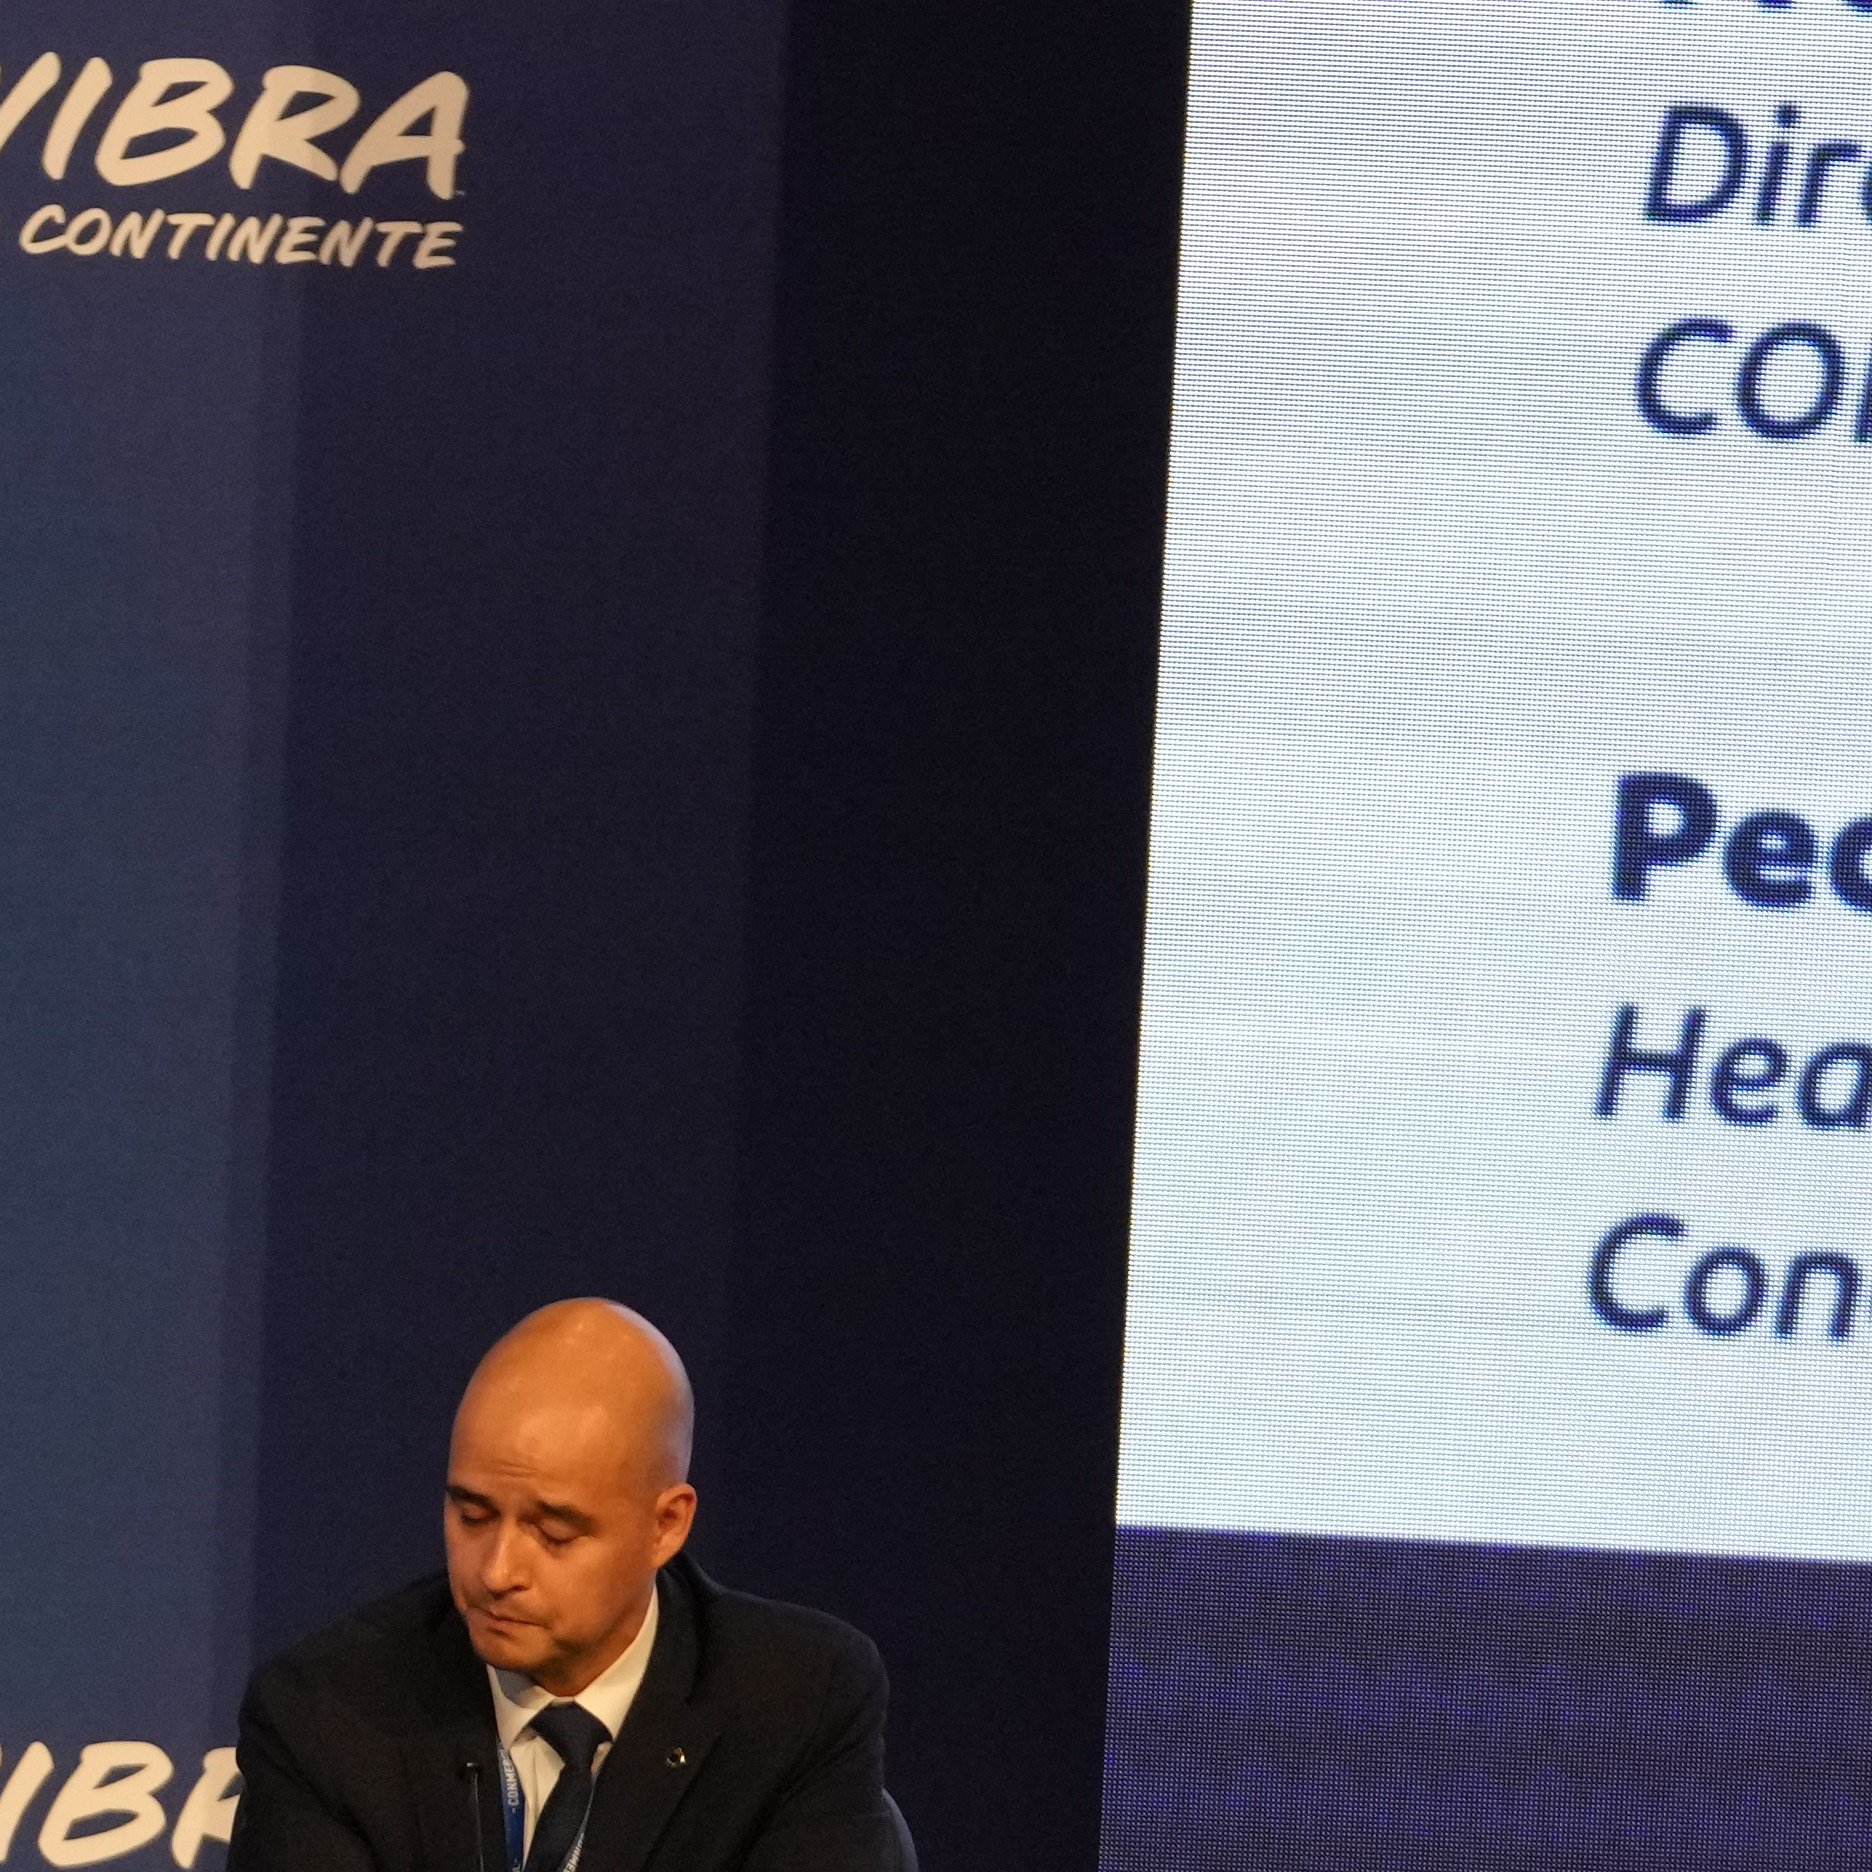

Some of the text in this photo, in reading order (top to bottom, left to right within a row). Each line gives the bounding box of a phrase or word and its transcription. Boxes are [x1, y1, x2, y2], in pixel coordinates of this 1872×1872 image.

[1643, 100, 1872, 228] Dir
[18, 203, 464, 269] CONTINENTE
[1634, 316, 1872, 443] CO
